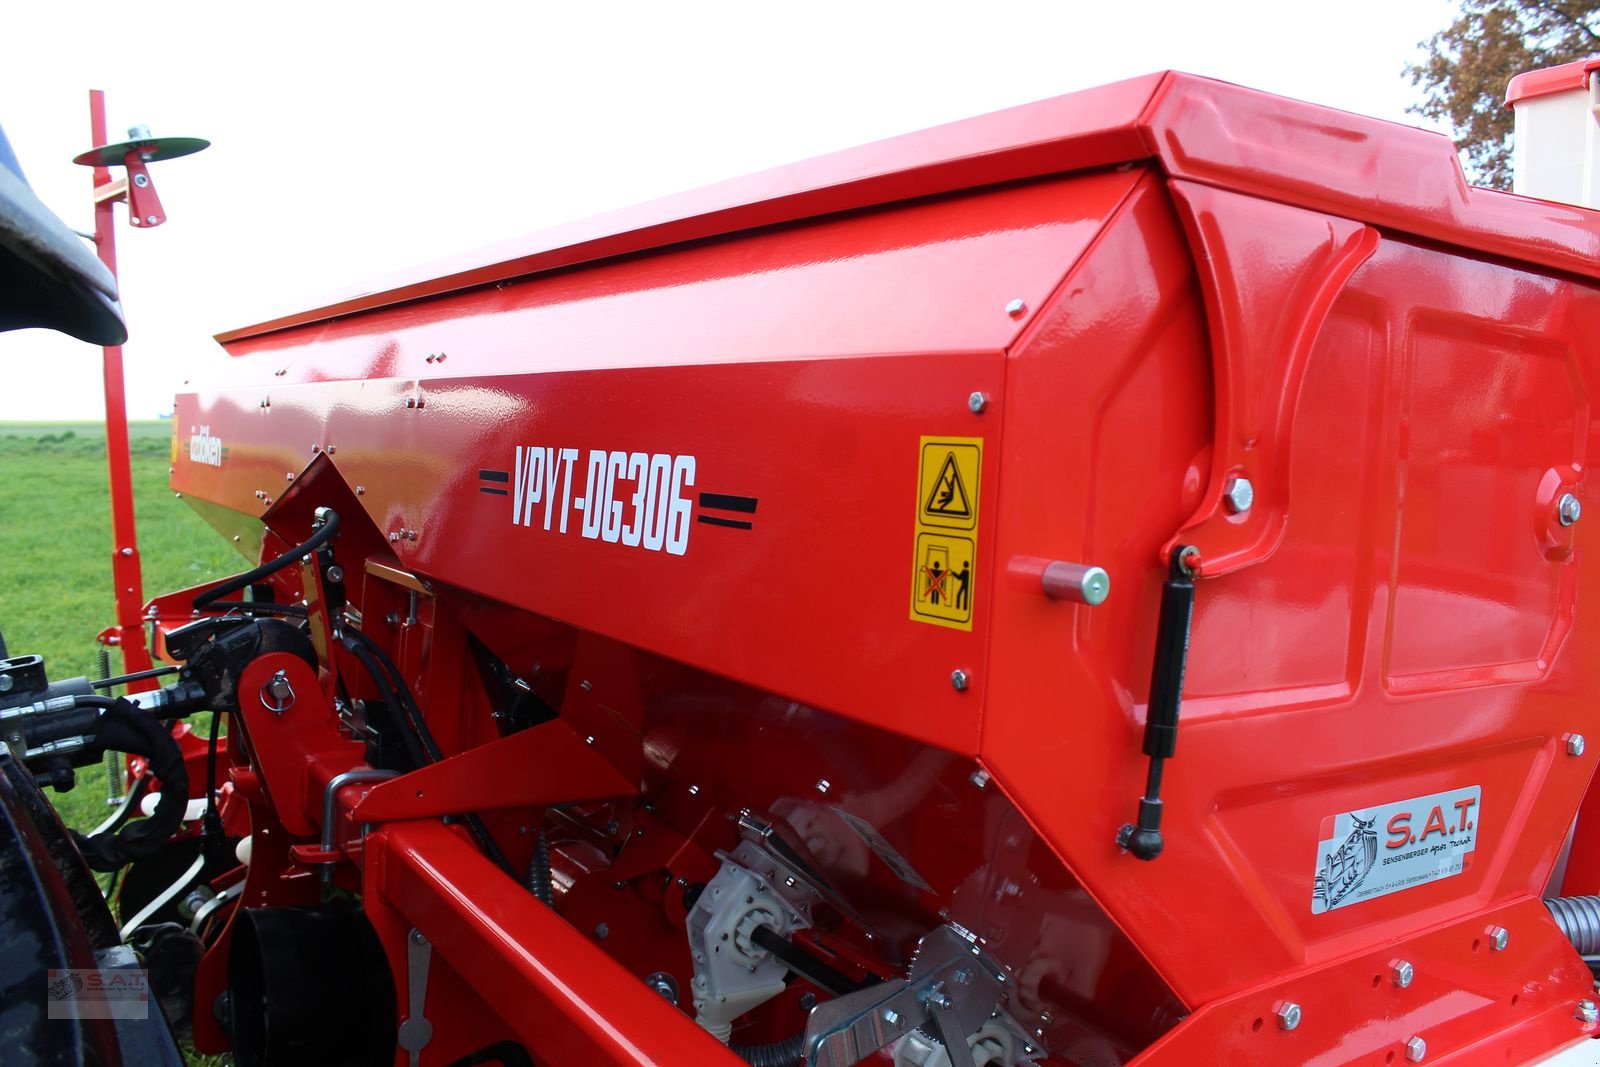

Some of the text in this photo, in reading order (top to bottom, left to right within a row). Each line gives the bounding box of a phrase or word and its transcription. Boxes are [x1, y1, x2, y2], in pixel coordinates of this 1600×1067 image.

[512, 445, 696, 556] VPYT-DG306
[1385, 797, 1476, 849] S.A.T.
[1382, 847, 1429, 866] SENSENBERGER
